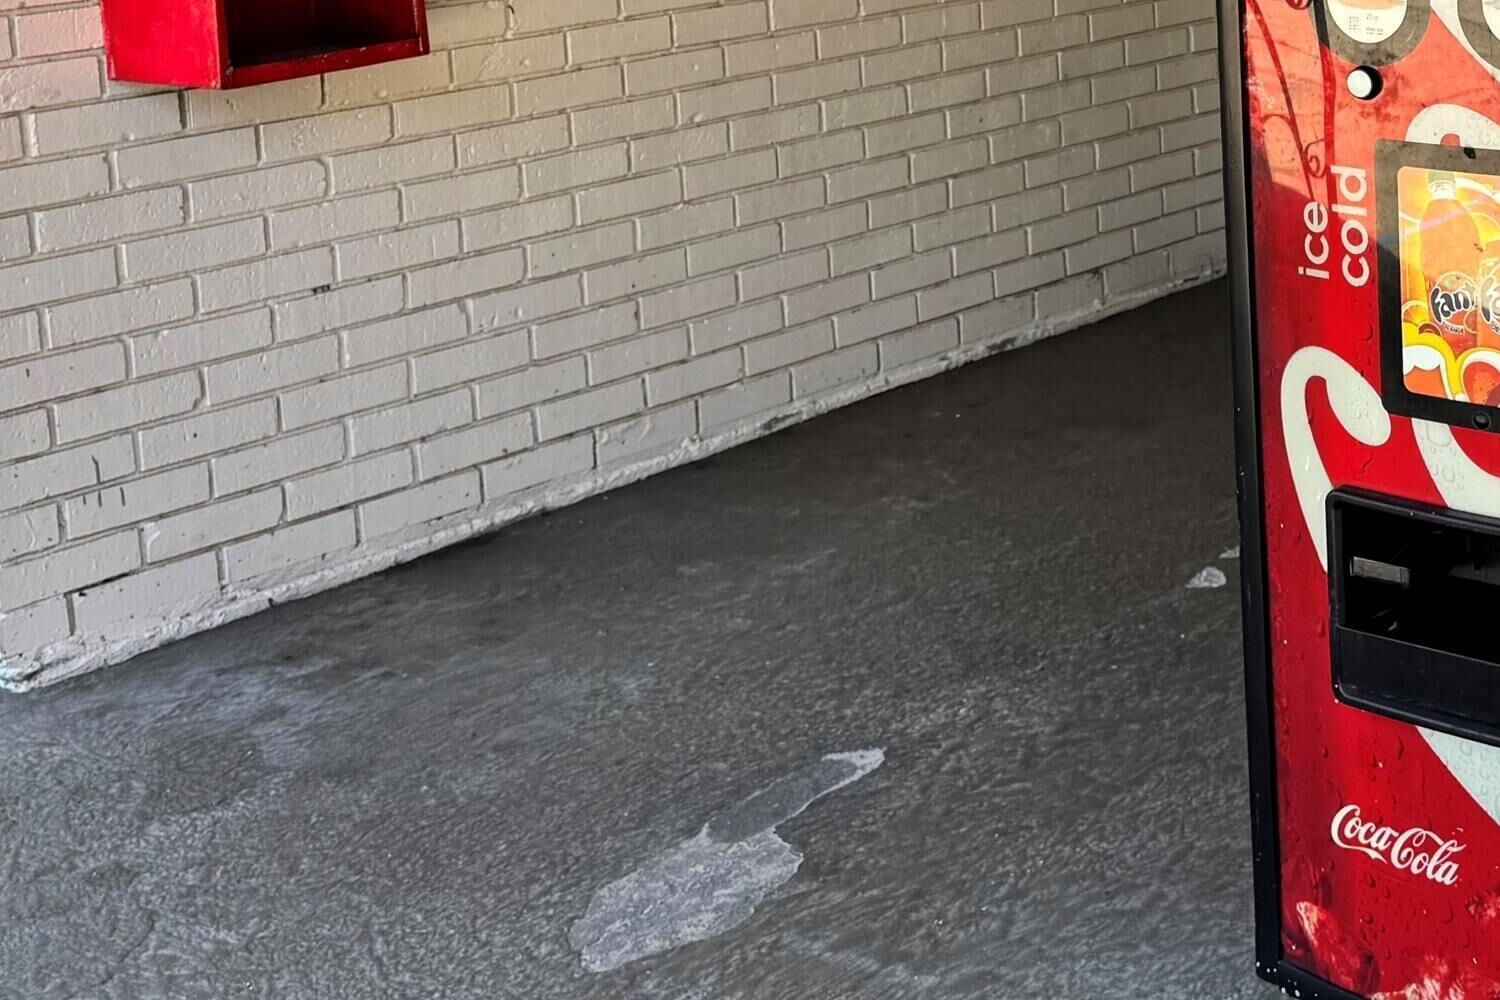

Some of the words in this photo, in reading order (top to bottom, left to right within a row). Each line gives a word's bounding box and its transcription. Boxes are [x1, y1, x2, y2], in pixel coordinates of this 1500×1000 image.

[1298, 201, 1330, 280] ice
[1330, 164, 1371, 287] cold
[1429, 283, 1478, 325] Fant
[1331, 804, 1467, 886] Coca-Cola
